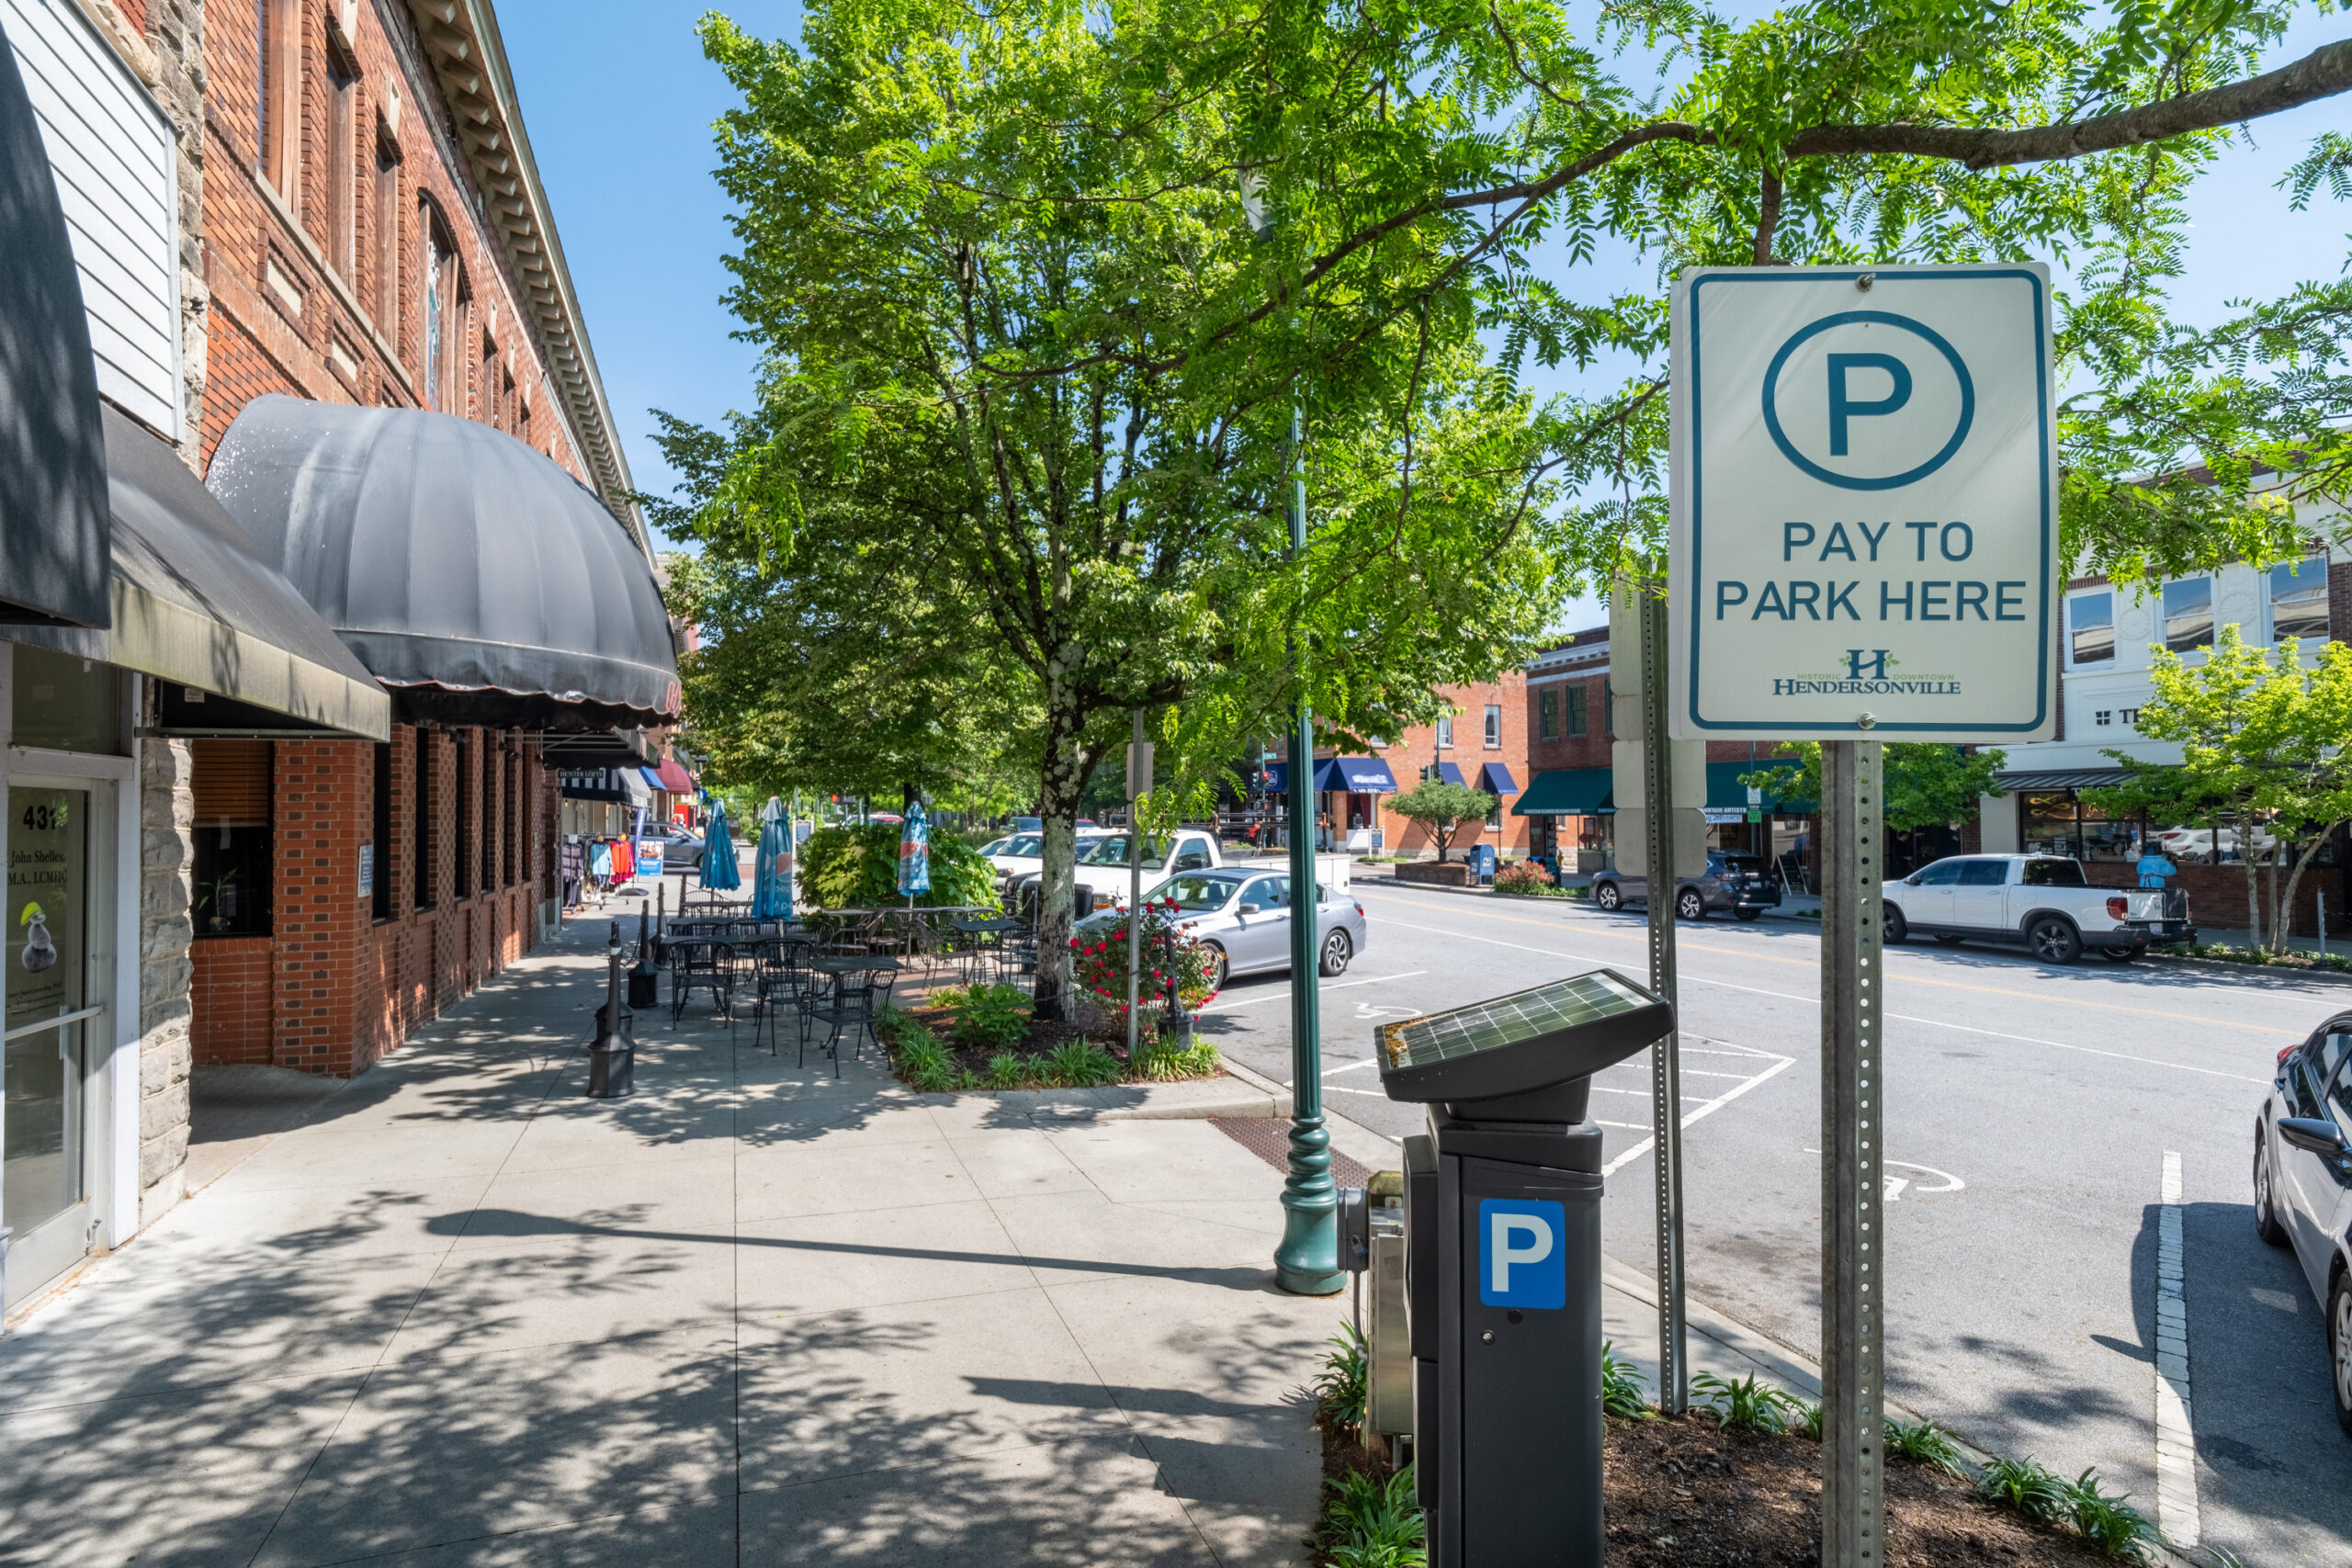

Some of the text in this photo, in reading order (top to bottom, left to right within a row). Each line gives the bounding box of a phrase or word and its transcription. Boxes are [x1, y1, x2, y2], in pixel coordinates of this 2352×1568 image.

[1827, 353, 1912, 456] P
[1783, 522, 1973, 561] PAY TO
[1716, 581, 2026, 621] PARK HERE
[1846, 649, 1889, 680] H
[10, 851, 32, 868] John
[1491, 1213, 1553, 1292] P
